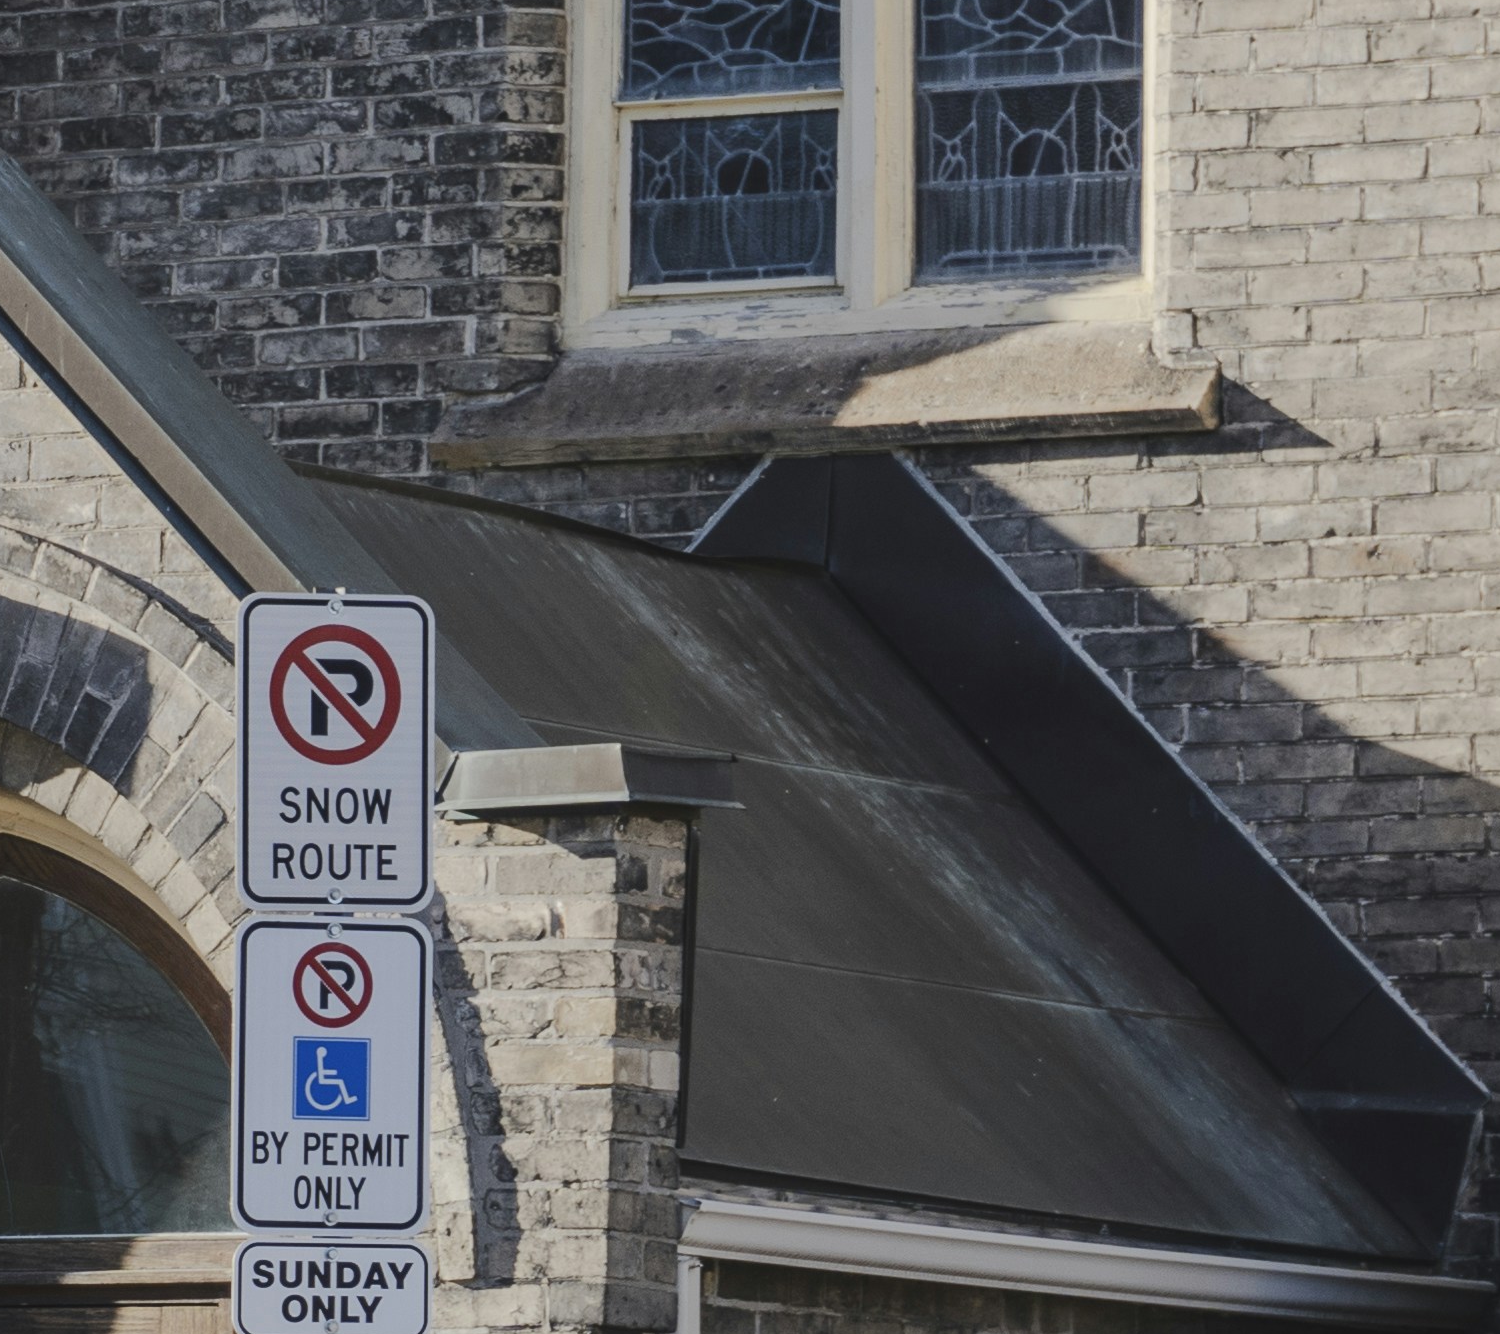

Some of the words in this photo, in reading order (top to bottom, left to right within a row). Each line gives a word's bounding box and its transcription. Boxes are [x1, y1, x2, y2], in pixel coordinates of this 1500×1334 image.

[279, 786, 392, 824] SNOW
[272, 842, 398, 881] ROUTE
[252, 1131, 289, 1165] BY
[303, 1132, 410, 1168] PERMIT
[293, 1175, 366, 1211] ONLY
[252, 1259, 414, 1291] SUNDAY
[281, 1294, 382, 1325] ONLY
